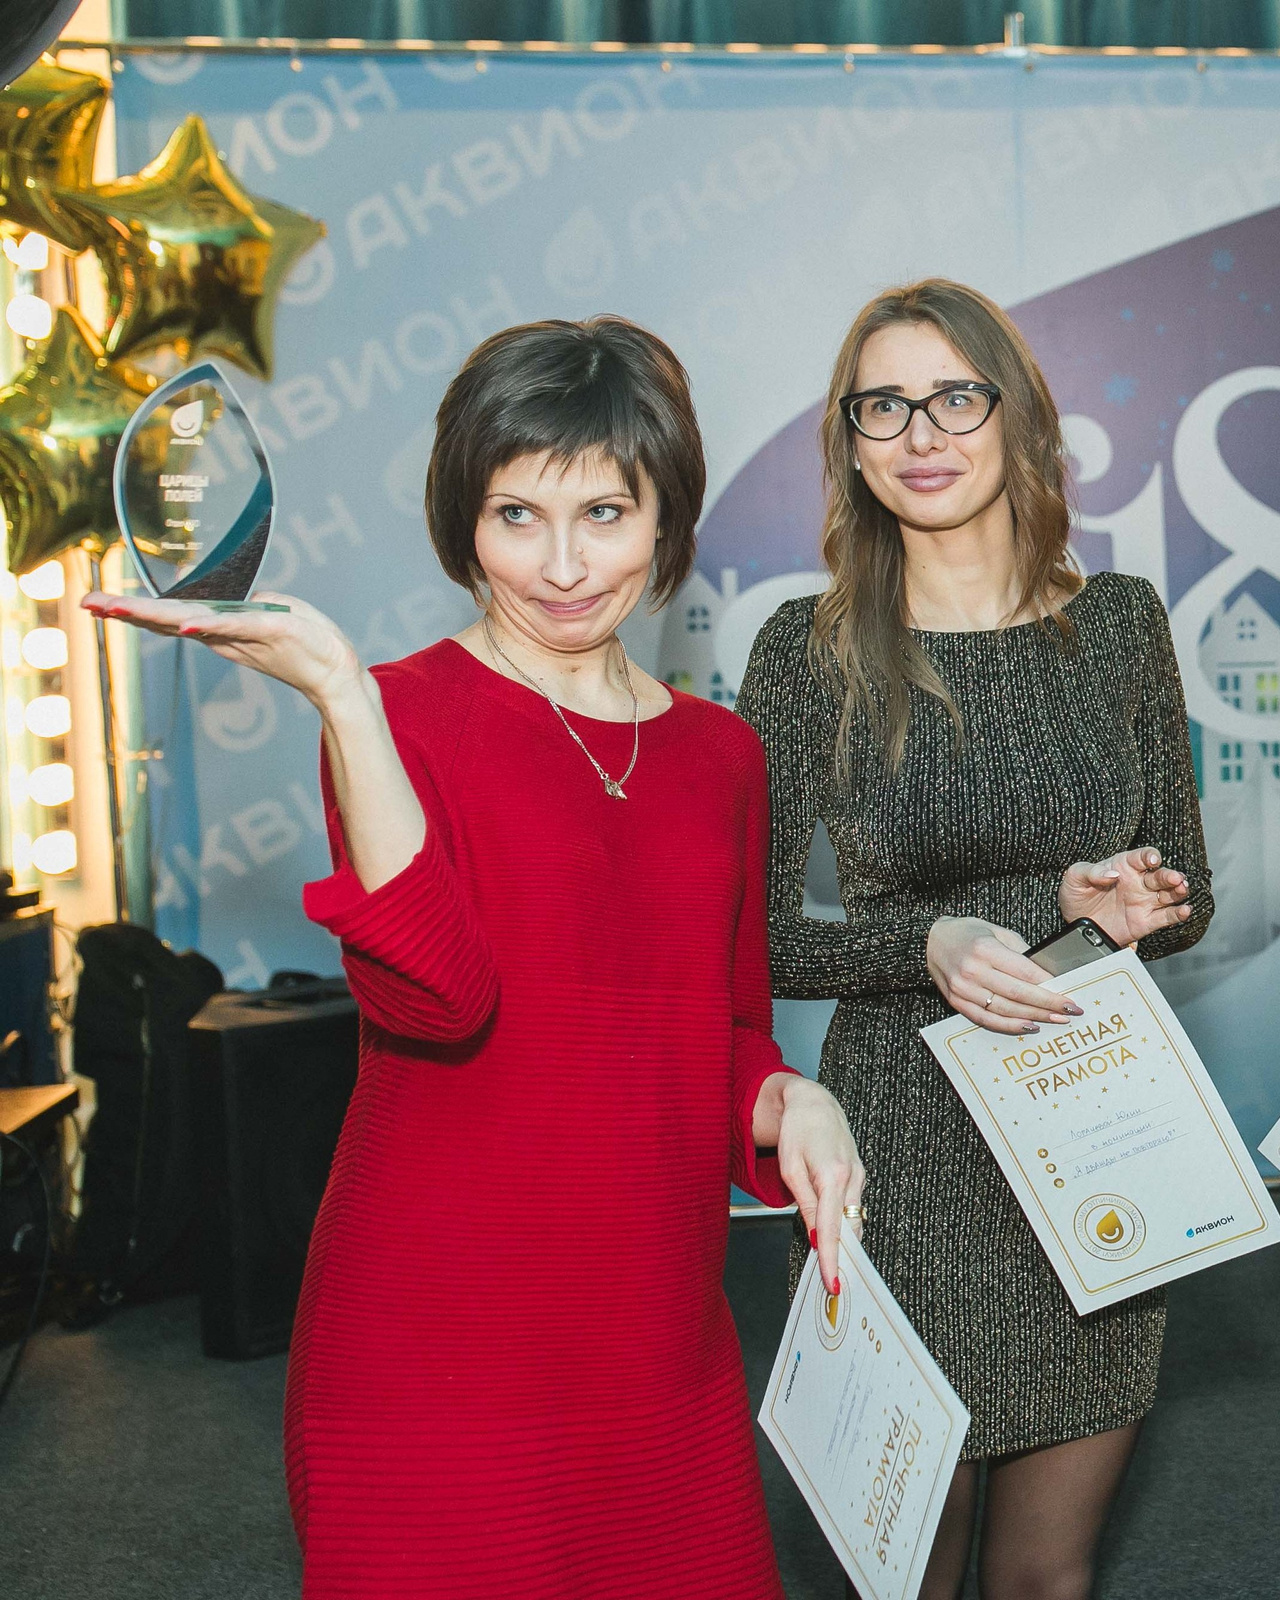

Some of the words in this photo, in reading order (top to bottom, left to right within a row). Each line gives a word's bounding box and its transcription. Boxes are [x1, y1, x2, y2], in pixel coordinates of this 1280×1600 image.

[346, 66, 706, 271] АКВИОН
[1002, 1013, 1128, 1076] ПОЧЕТНАЯ
[1025, 1045, 1138, 1100] ГРАМОТА
[1195, 1215, 1235, 1235] АКВИОН
[864, 1404, 904, 1527] ГРАМОТА
[876, 1419, 922, 1566] ПОЧЕТНАЯ
